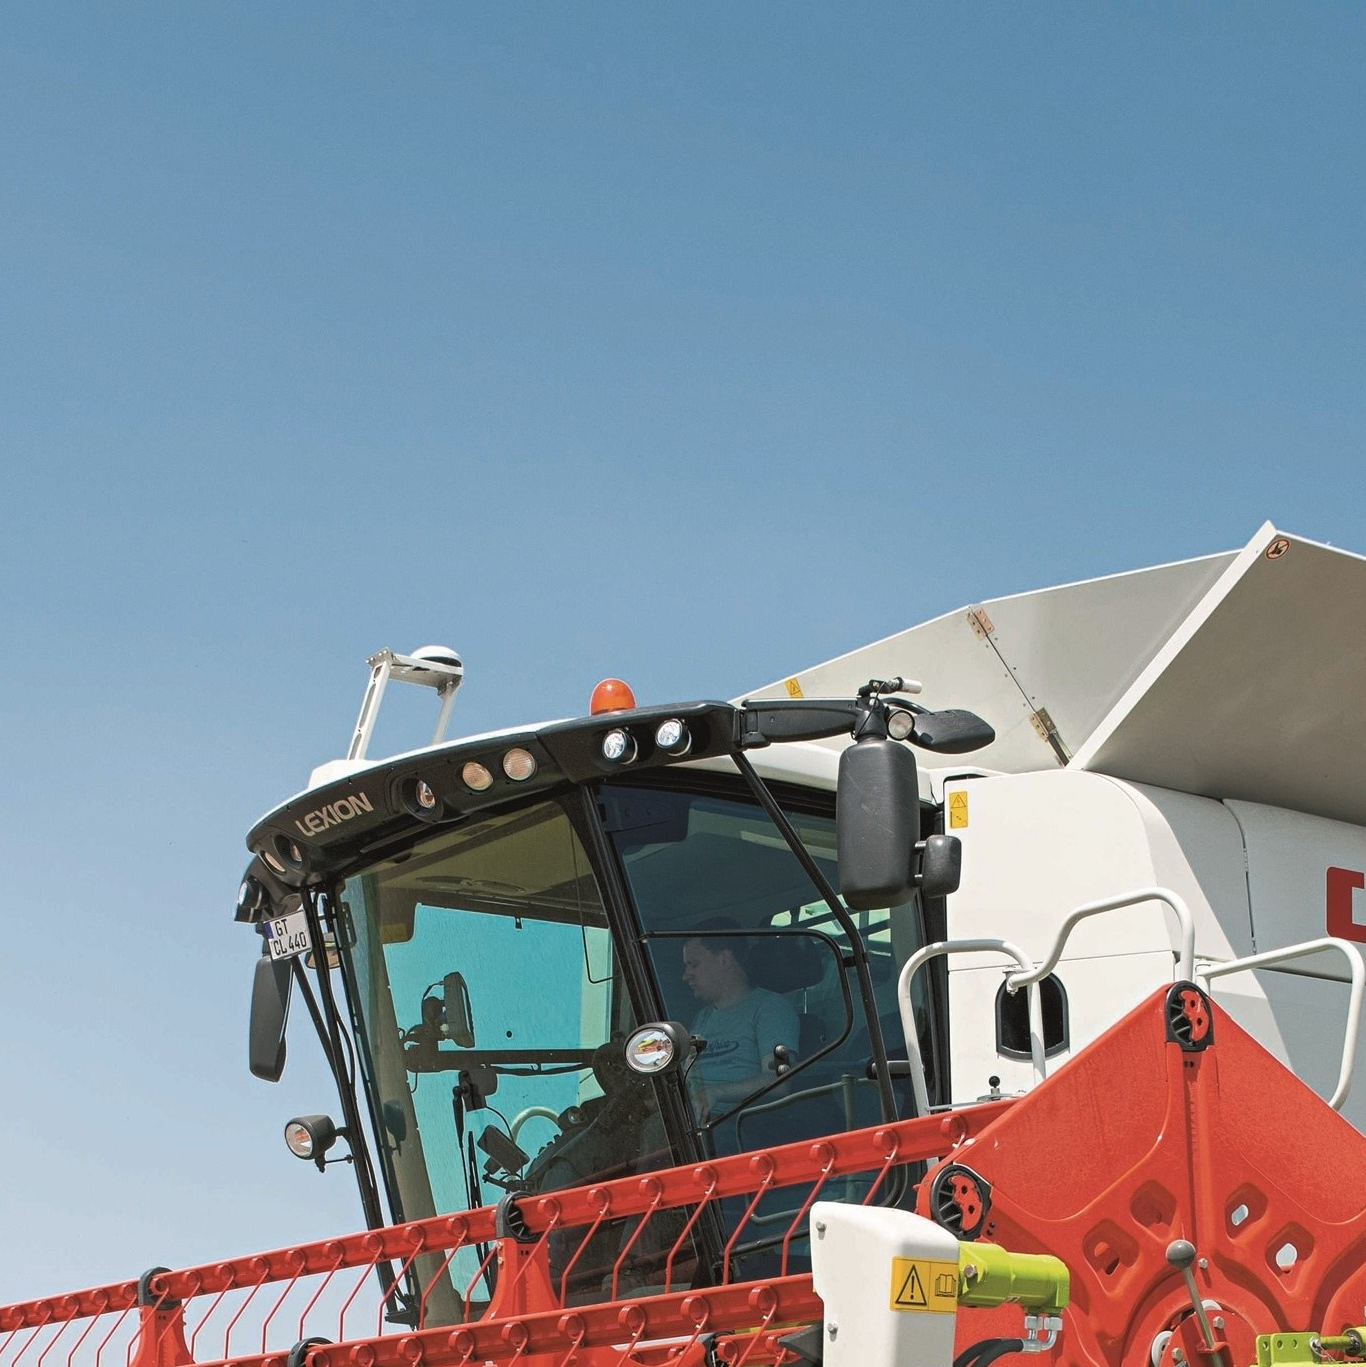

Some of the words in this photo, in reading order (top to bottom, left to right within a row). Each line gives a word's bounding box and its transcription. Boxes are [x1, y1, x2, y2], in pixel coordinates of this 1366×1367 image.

[295, 792, 375, 837] LEXION
[275, 919, 289, 937] GT
[274, 940, 288, 956] CL
[288, 931, 307, 951] 440
